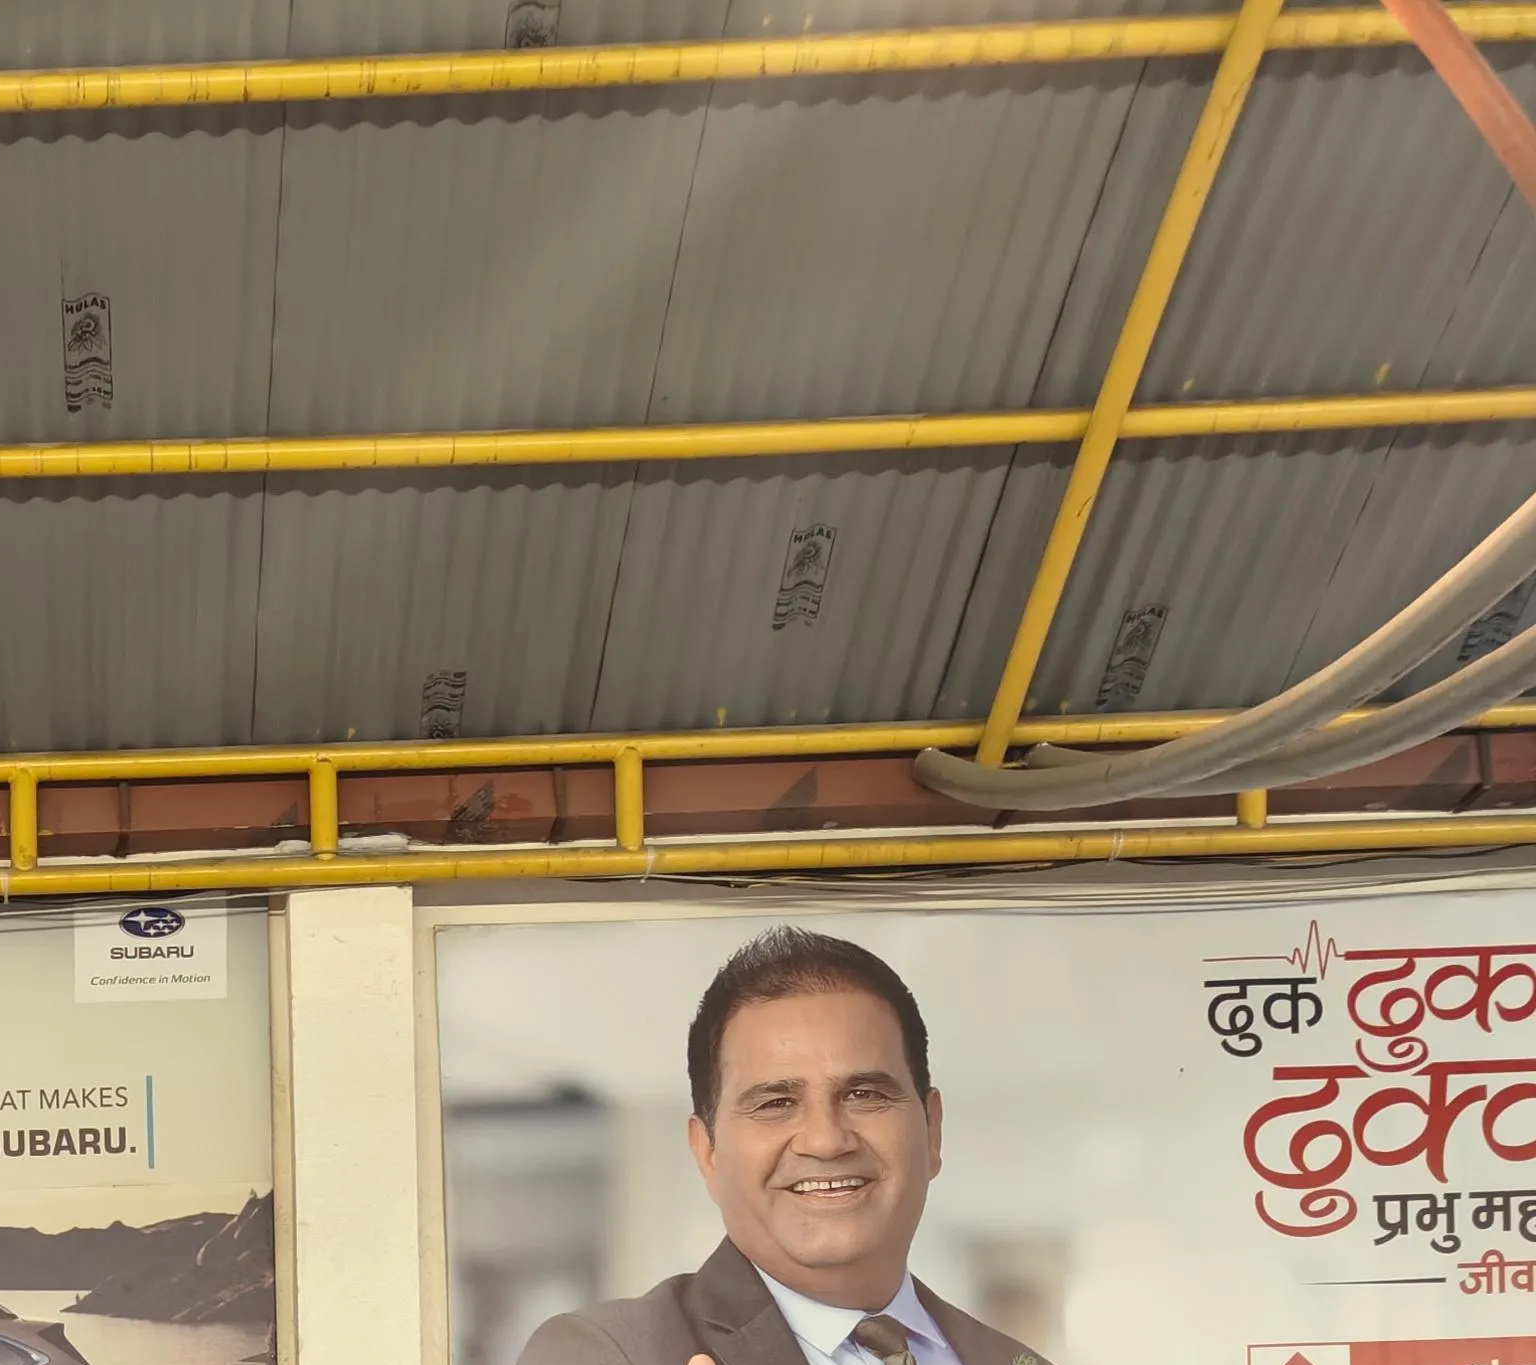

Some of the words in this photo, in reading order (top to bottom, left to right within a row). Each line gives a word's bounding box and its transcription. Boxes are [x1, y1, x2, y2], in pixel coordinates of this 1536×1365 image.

[109, 944, 195, 961] SUBARU
[90, 974, 157, 987] Confidence
[158, 974, 169, 985] in
[170, 973, 211, 984] Motion
[1203, 976, 1324, 1058] ढुक
[39, 1086, 129, 1110] MAKES
[1372, 1191, 1462, 1254] प्रभु
